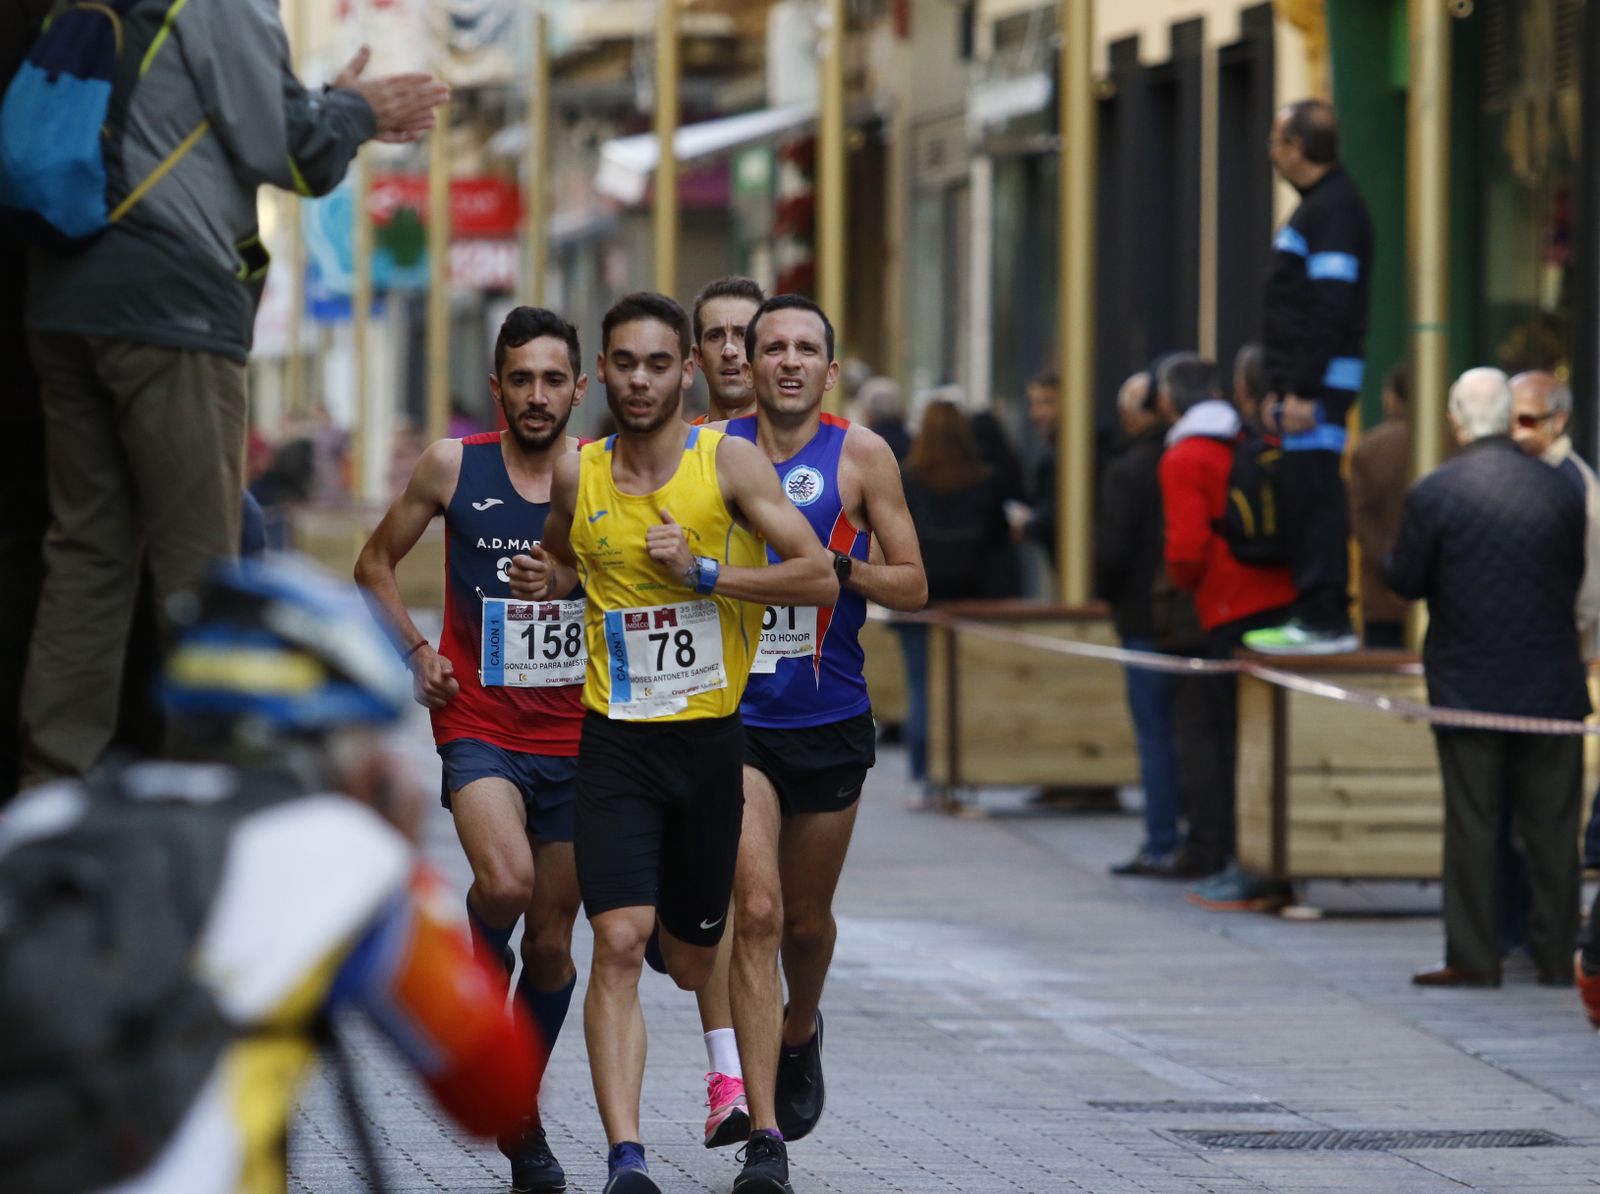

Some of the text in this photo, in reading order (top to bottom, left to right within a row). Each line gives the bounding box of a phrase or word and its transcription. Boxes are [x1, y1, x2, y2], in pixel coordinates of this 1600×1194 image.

[489, 627, 500, 666] CAJÓN
[520, 622, 582, 660] 158
[648, 628, 697, 672] 78
[778, 632, 810, 643] HONOR
[504, 662, 538, 670] GONZALO
[539, 661, 562, 670] PARRA
[653, 671, 690, 682] ANTONETE
[690, 663, 719, 677] SANCHEZ
